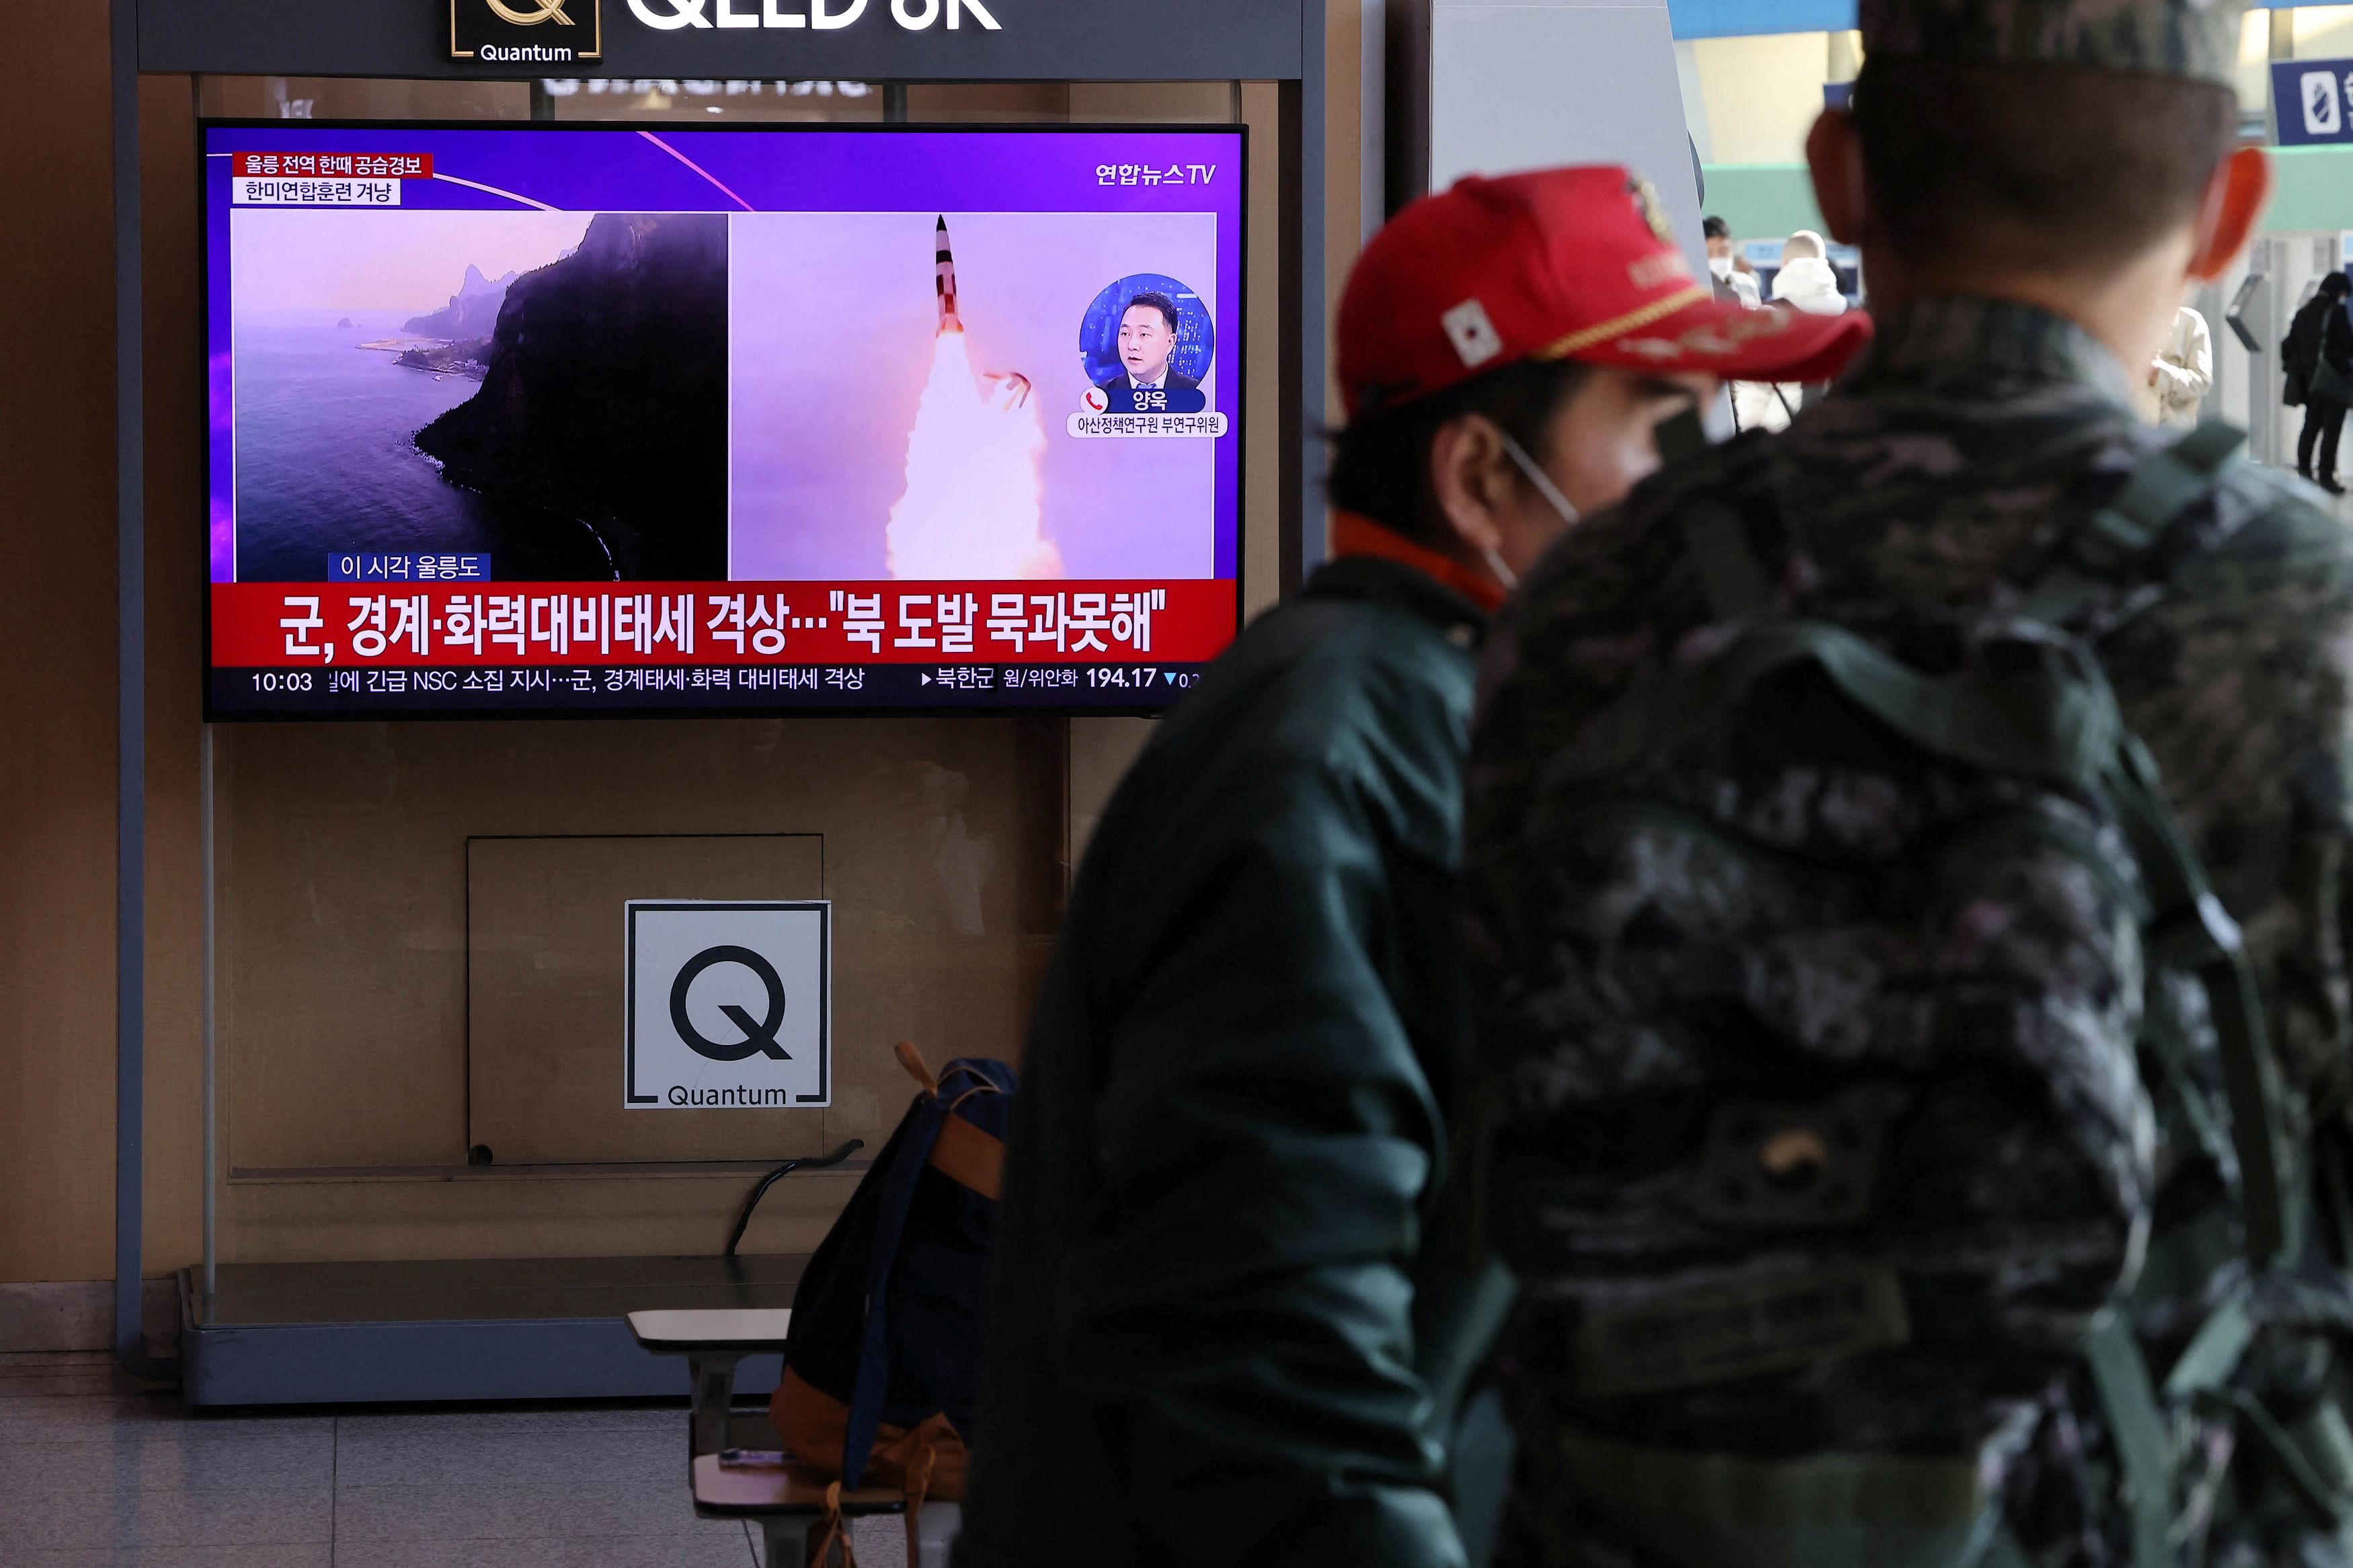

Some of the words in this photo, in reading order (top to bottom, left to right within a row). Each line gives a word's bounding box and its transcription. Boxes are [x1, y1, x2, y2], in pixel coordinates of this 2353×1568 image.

[481, 44, 571, 61] Quantum
[245, 155, 280, 174] 울릉
[282, 155, 315, 175] 전역
[319, 156, 352, 175] 한때
[354, 156, 422, 175] 공습경보
[1094, 163, 1217, 186] 연합뉴스TV
[246, 181, 352, 202] 한미연합훈련
[356, 183, 392, 202] 겨냥
[1132, 390, 1168, 411] 양욱
[1078, 417, 1158, 434] 아산정책연구원
[1162, 417, 1219, 434] 부연구위원
[341, 556, 360, 579] 이
[367, 556, 411, 579] 시각
[416, 556, 481, 579] 울릉도
[280, 596, 334, 664] 군,
[346, 593, 694, 657] 경계·화력대비태세
[893, 593, 978, 653] 도발
[986, 589, 1166, 653] 묵과못해"
[252, 673, 313, 692] 10:03
[366, 670, 408, 692] 긴급
[413, 671, 457, 691] NSC
[463, 669, 503, 692] 소집
[604, 668, 731, 692] 경계태세·화력
[739, 668, 818, 690] 대비태세
[824, 668, 865, 690] 격상
[935, 667, 994, 689] 북한군
[1003, 668, 1078, 688] 원/위안화
[1086, 668, 1158, 688] 194.17
[670, 945, 793, 1061] Q
[668, 1085, 787, 1106] Quantum
